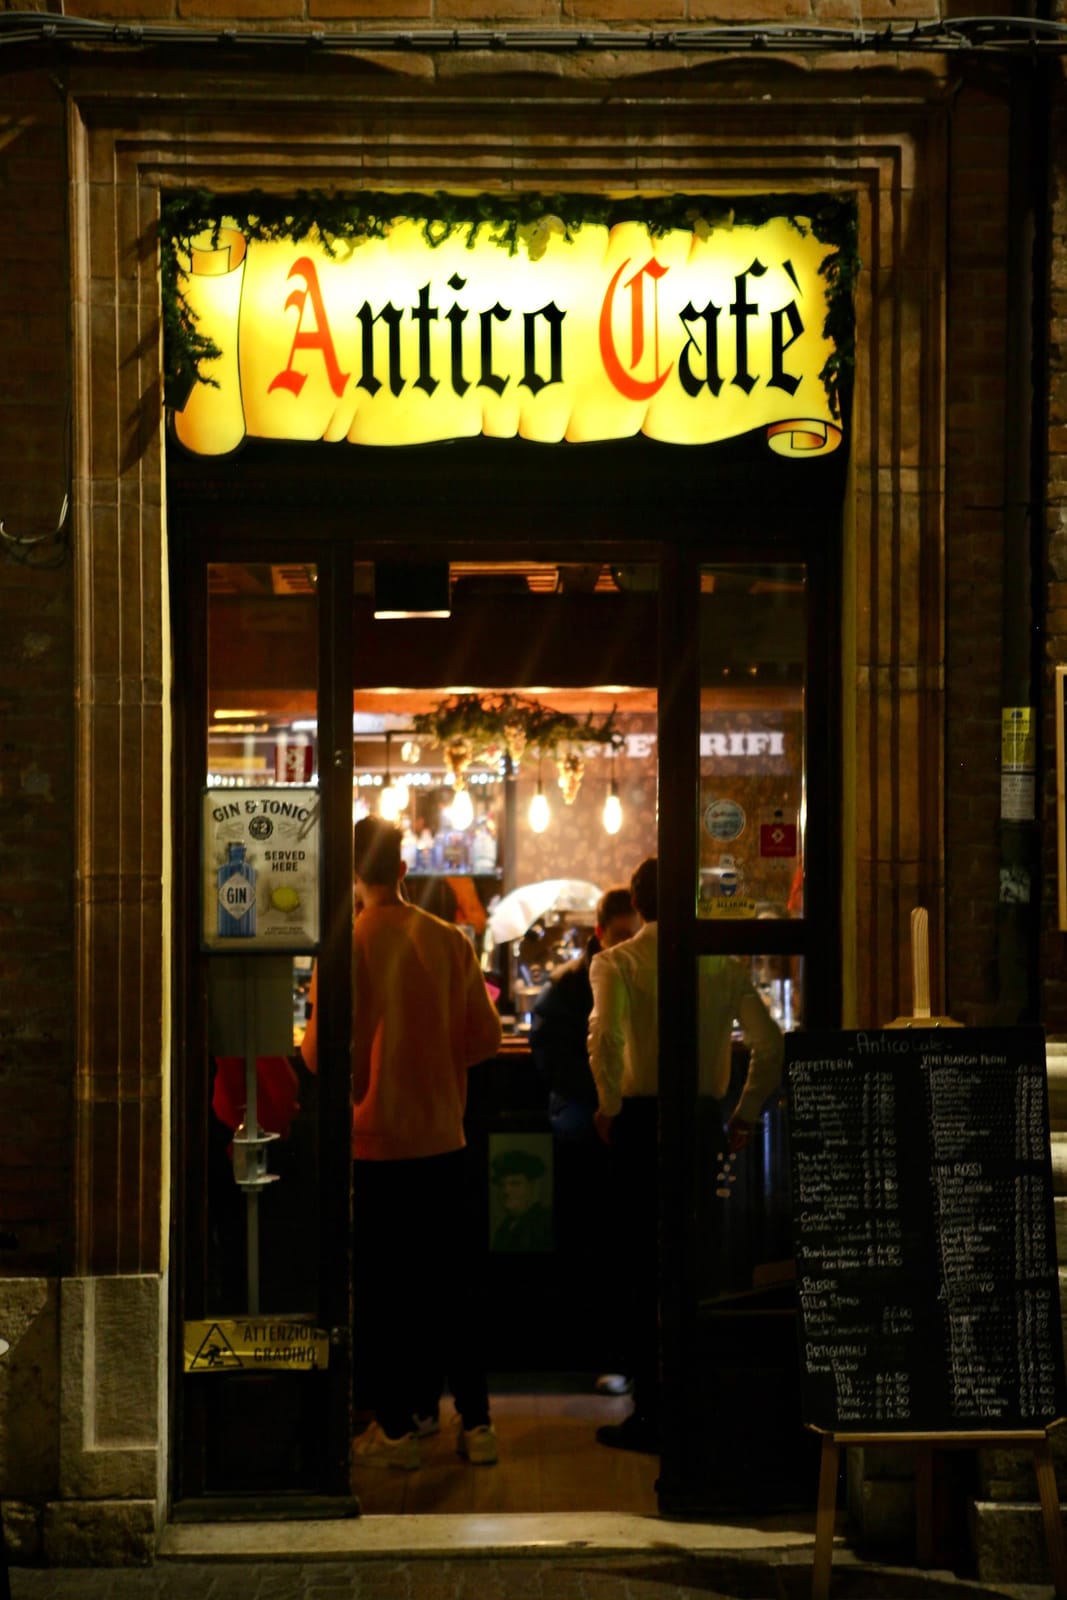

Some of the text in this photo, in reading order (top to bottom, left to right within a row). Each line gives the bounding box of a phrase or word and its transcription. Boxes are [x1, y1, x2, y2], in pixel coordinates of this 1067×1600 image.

[267, 257, 806, 401] Antico Cafè
[212, 799, 311, 822] GIN & TONIC
[264, 851, 305, 861] SERVED
[272, 862, 298, 872] HERE
[226, 887, 247, 904] GIN
[953, 1162, 983, 1176] ROSSI
[243, 1325, 319, 1343] ATTENZION
